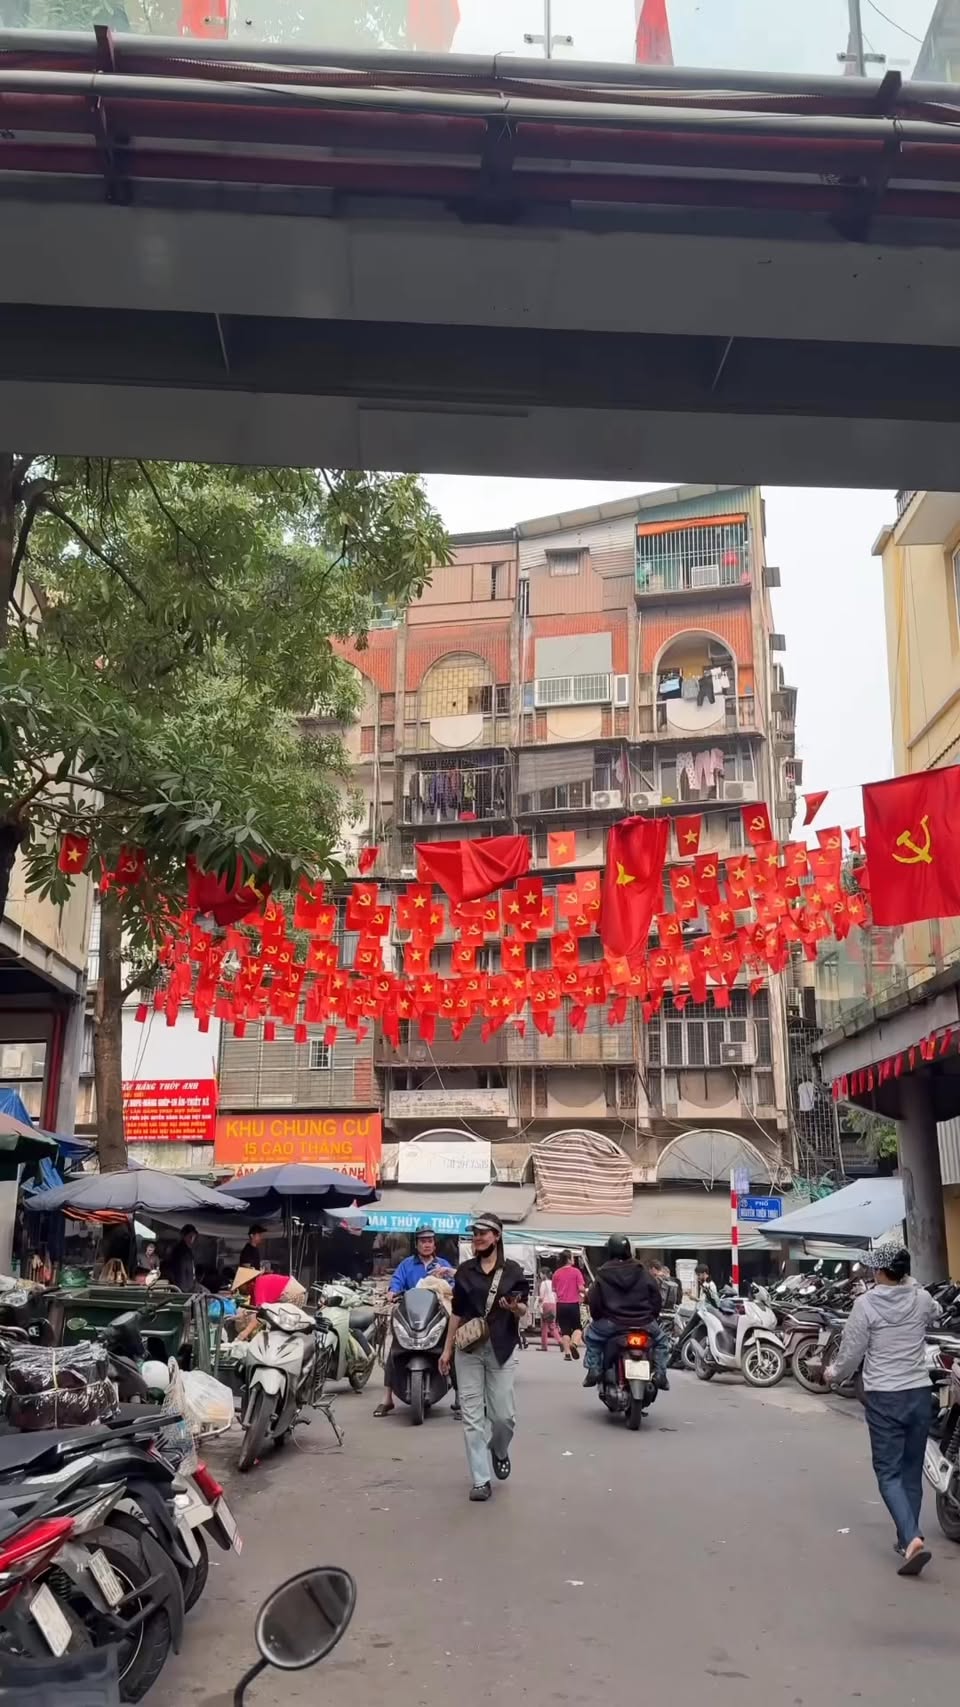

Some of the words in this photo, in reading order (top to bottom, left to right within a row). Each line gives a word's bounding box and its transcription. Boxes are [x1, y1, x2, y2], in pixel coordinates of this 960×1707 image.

[226, 1119, 265, 1137] KHU
[270, 1118, 337, 1137] CHUNG
[245, 1143, 257, 1155] 15
[262, 1142, 294, 1155] CAO
